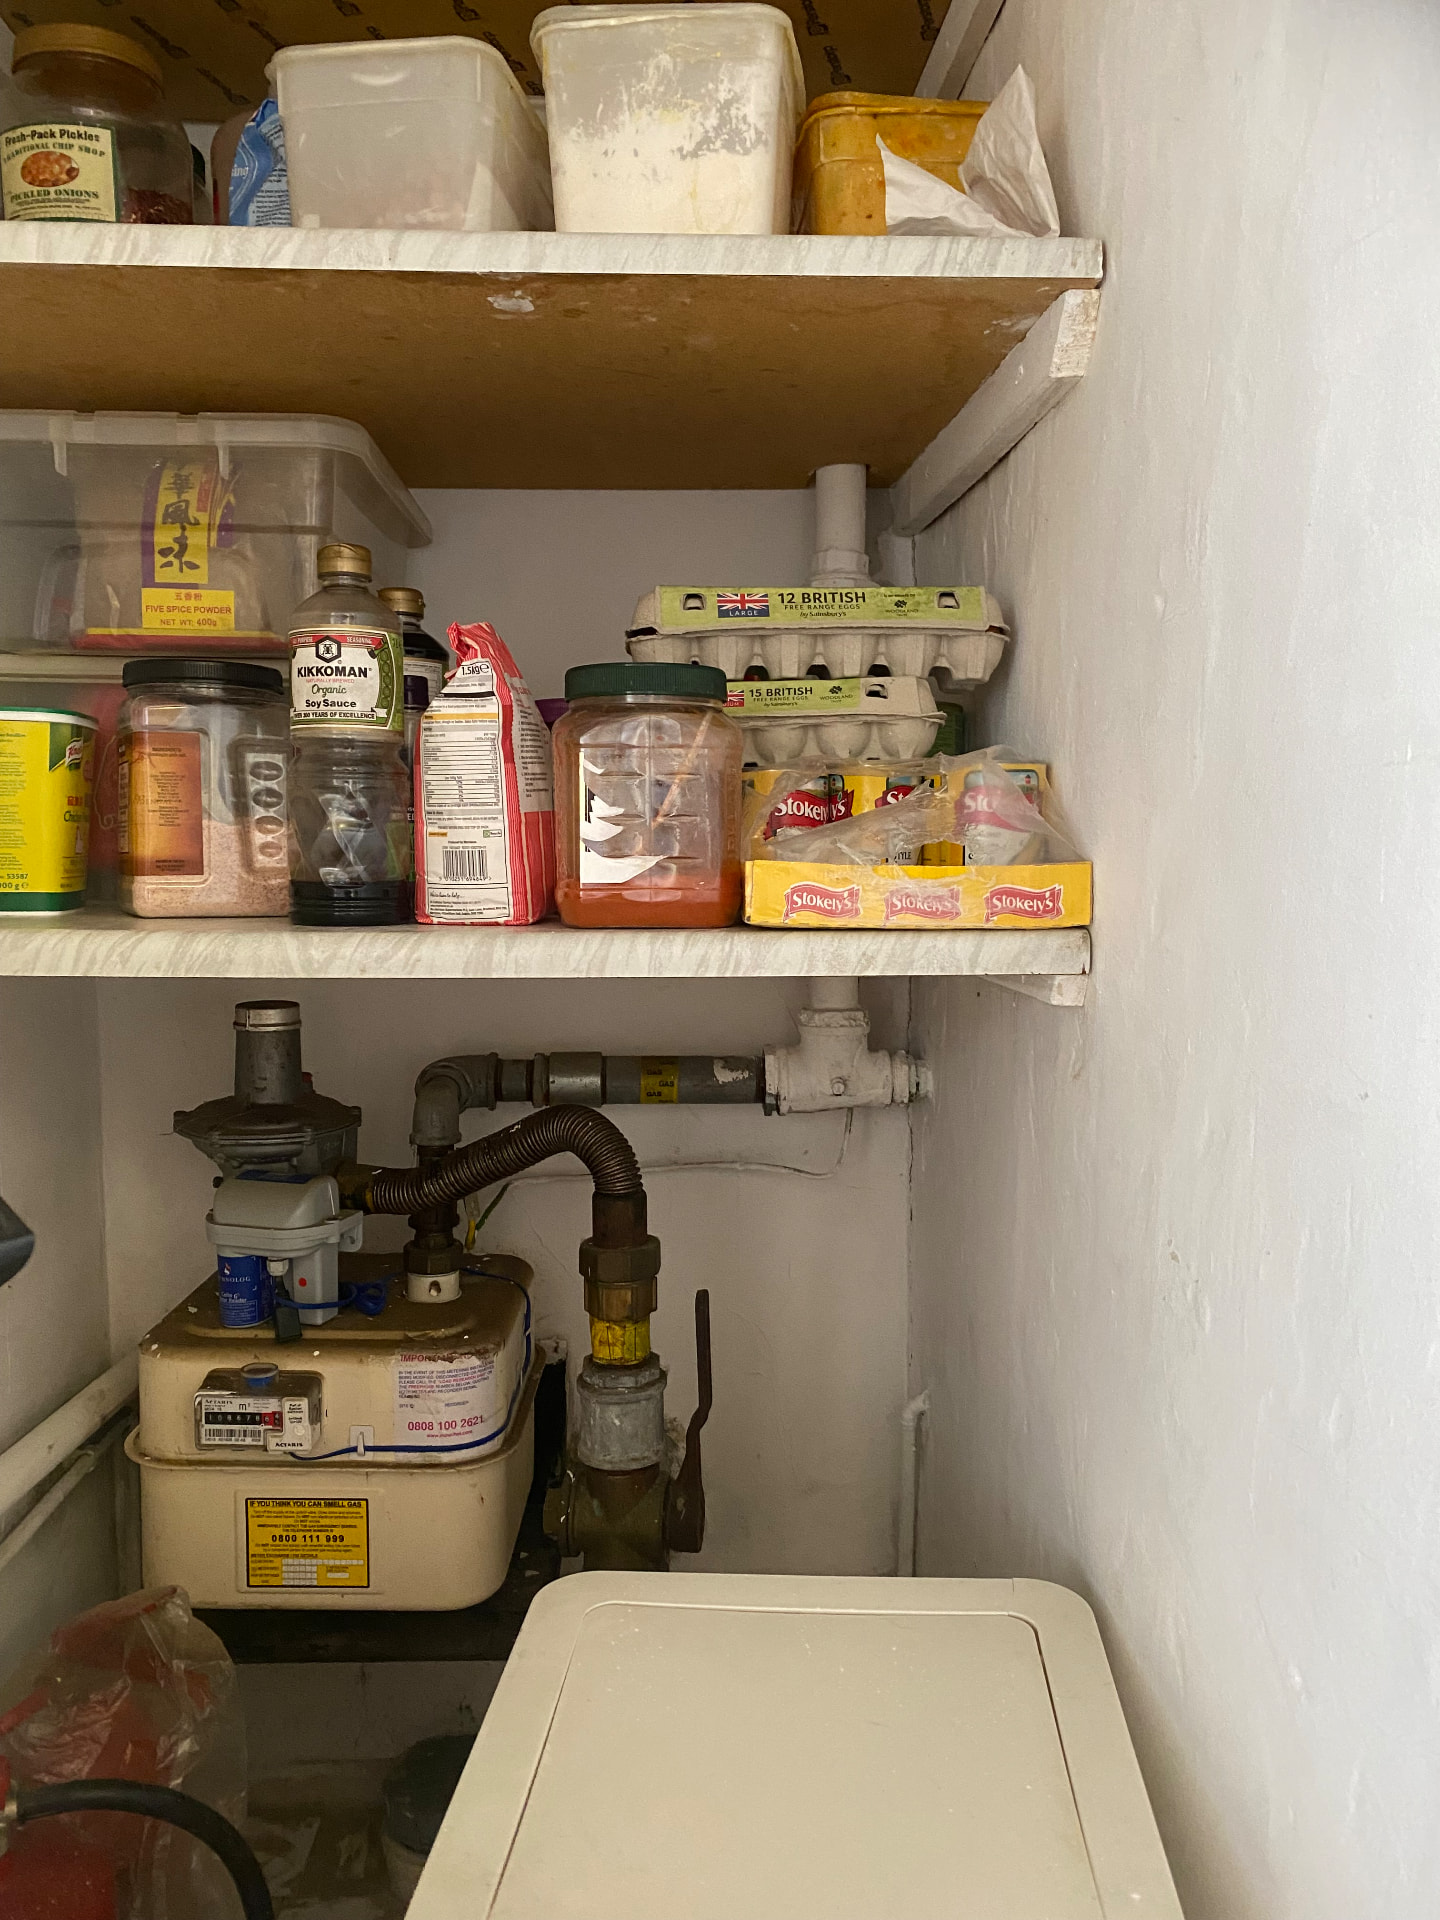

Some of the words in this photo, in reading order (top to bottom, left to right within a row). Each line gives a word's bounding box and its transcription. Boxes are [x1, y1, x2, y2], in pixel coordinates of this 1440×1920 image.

[5, 129, 56, 147] Fresh-Pack
[59, 129, 100, 142] Pickles
[4, 143, 50, 163] TRADITIONAL
[78, 145, 105, 157] SHOP
[10, 189, 51, 202] PICKLED
[54, 189, 100, 199] ONIONS
[778, 592, 796, 604] 12
[802, 592, 866, 604] BRITISH
[145, 605, 164, 613] FIVE
[166, 605, 192, 613] SPICE
[194, 606, 232, 614] POWDER
[196, 618, 217, 627] 400g
[297, 666, 368, 678] KIKKOMAN
[312, 684, 347, 698] Organic
[749, 688, 762, 698] 15
[766, 687, 813, 697] BRITISH
[305, 699, 321, 709] Soy
[322, 699, 357, 708] Sauce
[338, 711, 375, 719] EXCELLENCE
[894, 851, 912, 863] TYLE
[792, 891, 852, 912] Stokely's
[892, 891, 952, 913] Stokely's
[991, 890, 1054, 912] Stokely's
[408, 1421, 434, 1431] 0808
[438, 1420, 457, 1430] 100
[460, 1415, 484, 1428] 2621
[293, 1500, 306, 1508] YOU
[271, 1535, 297, 1543] 0800
[302, 1535, 320, 1543] 111
[325, 1535, 345, 1543] 999
